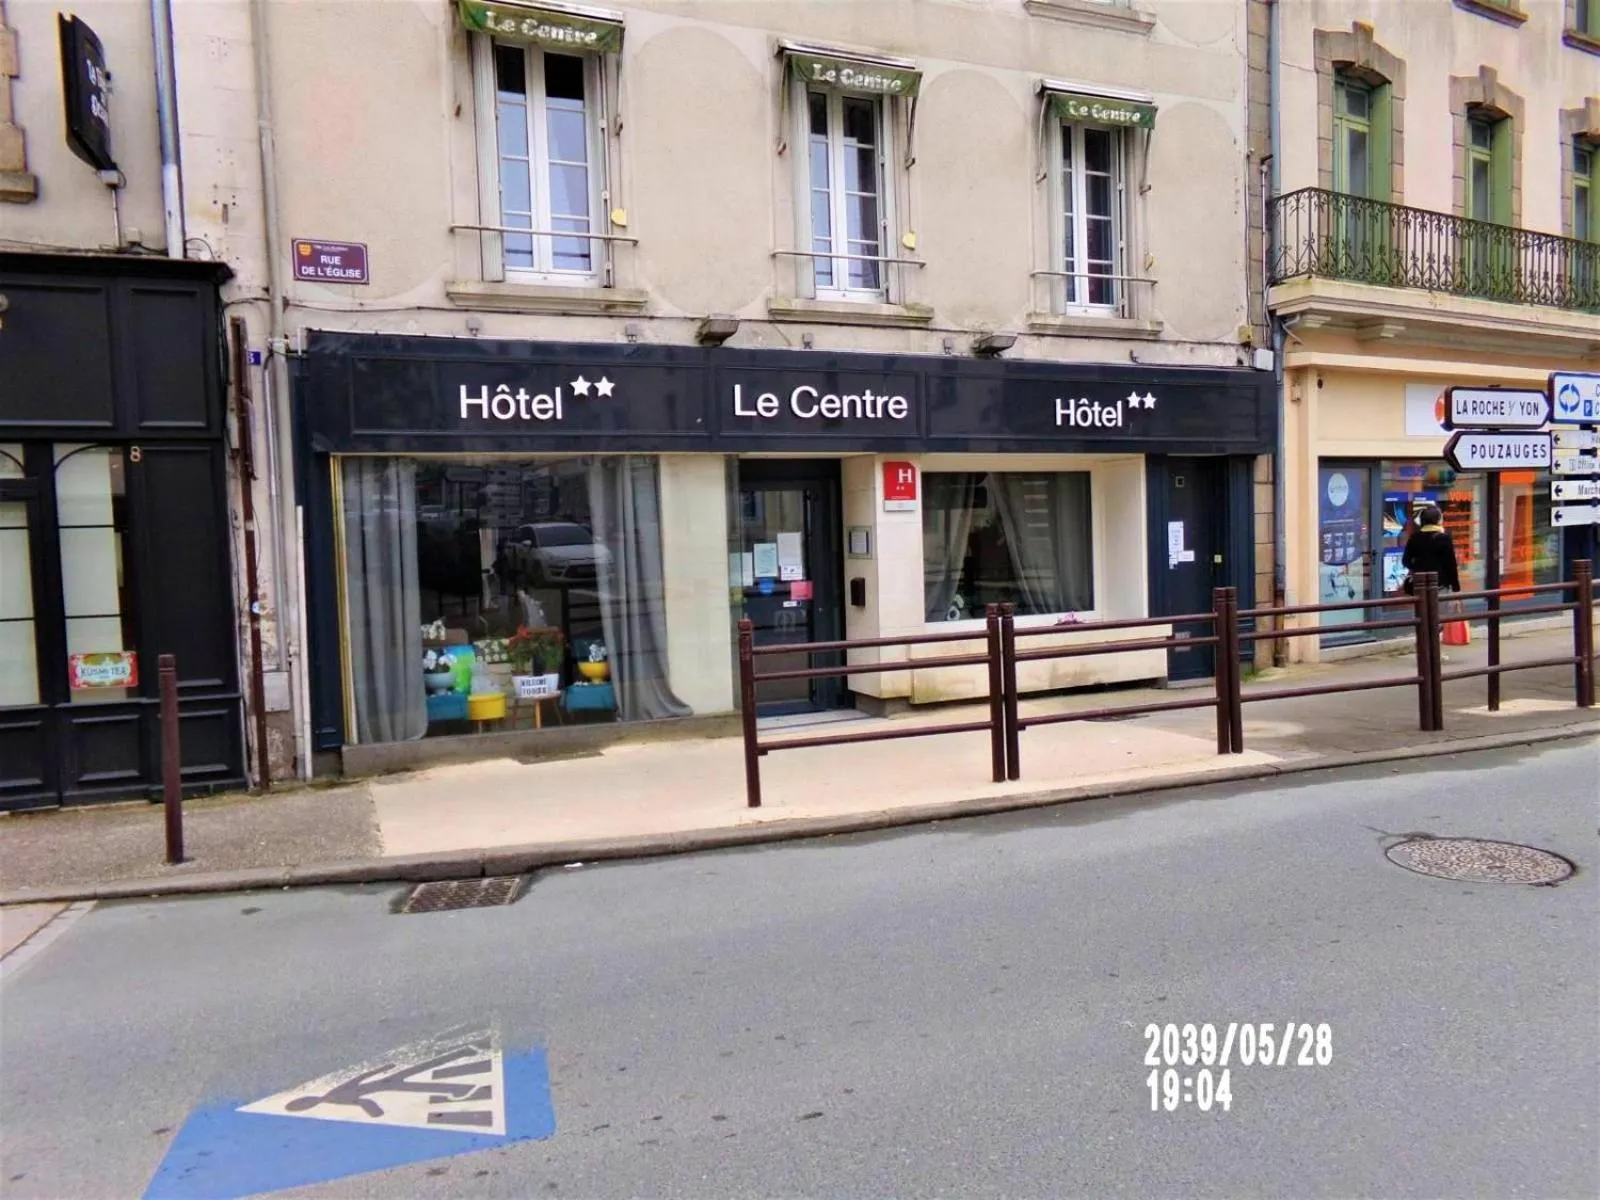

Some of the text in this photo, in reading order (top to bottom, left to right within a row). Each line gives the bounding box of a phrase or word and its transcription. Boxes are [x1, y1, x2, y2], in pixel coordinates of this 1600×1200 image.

[485, 11, 598, 44] Le Centre
[812, 62, 902, 91] Le Centre
[1091, 104, 1141, 123] Centre
[320, 255, 342, 265] RUE
[301, 265, 317, 276] DE
[459, 383, 563, 421] Hôtel
[733, 383, 909, 419] Le Centre
[1455, 399, 1469, 416] LA
[1471, 400, 1505, 417] ROCHE
[1519, 400, 1540, 417] YON
[1055, 397, 1123, 428] Hôtel
[130, 446, 141, 462] 8
[1470, 443, 1548, 460] POUZAUGES
[898, 468, 912, 484] H
